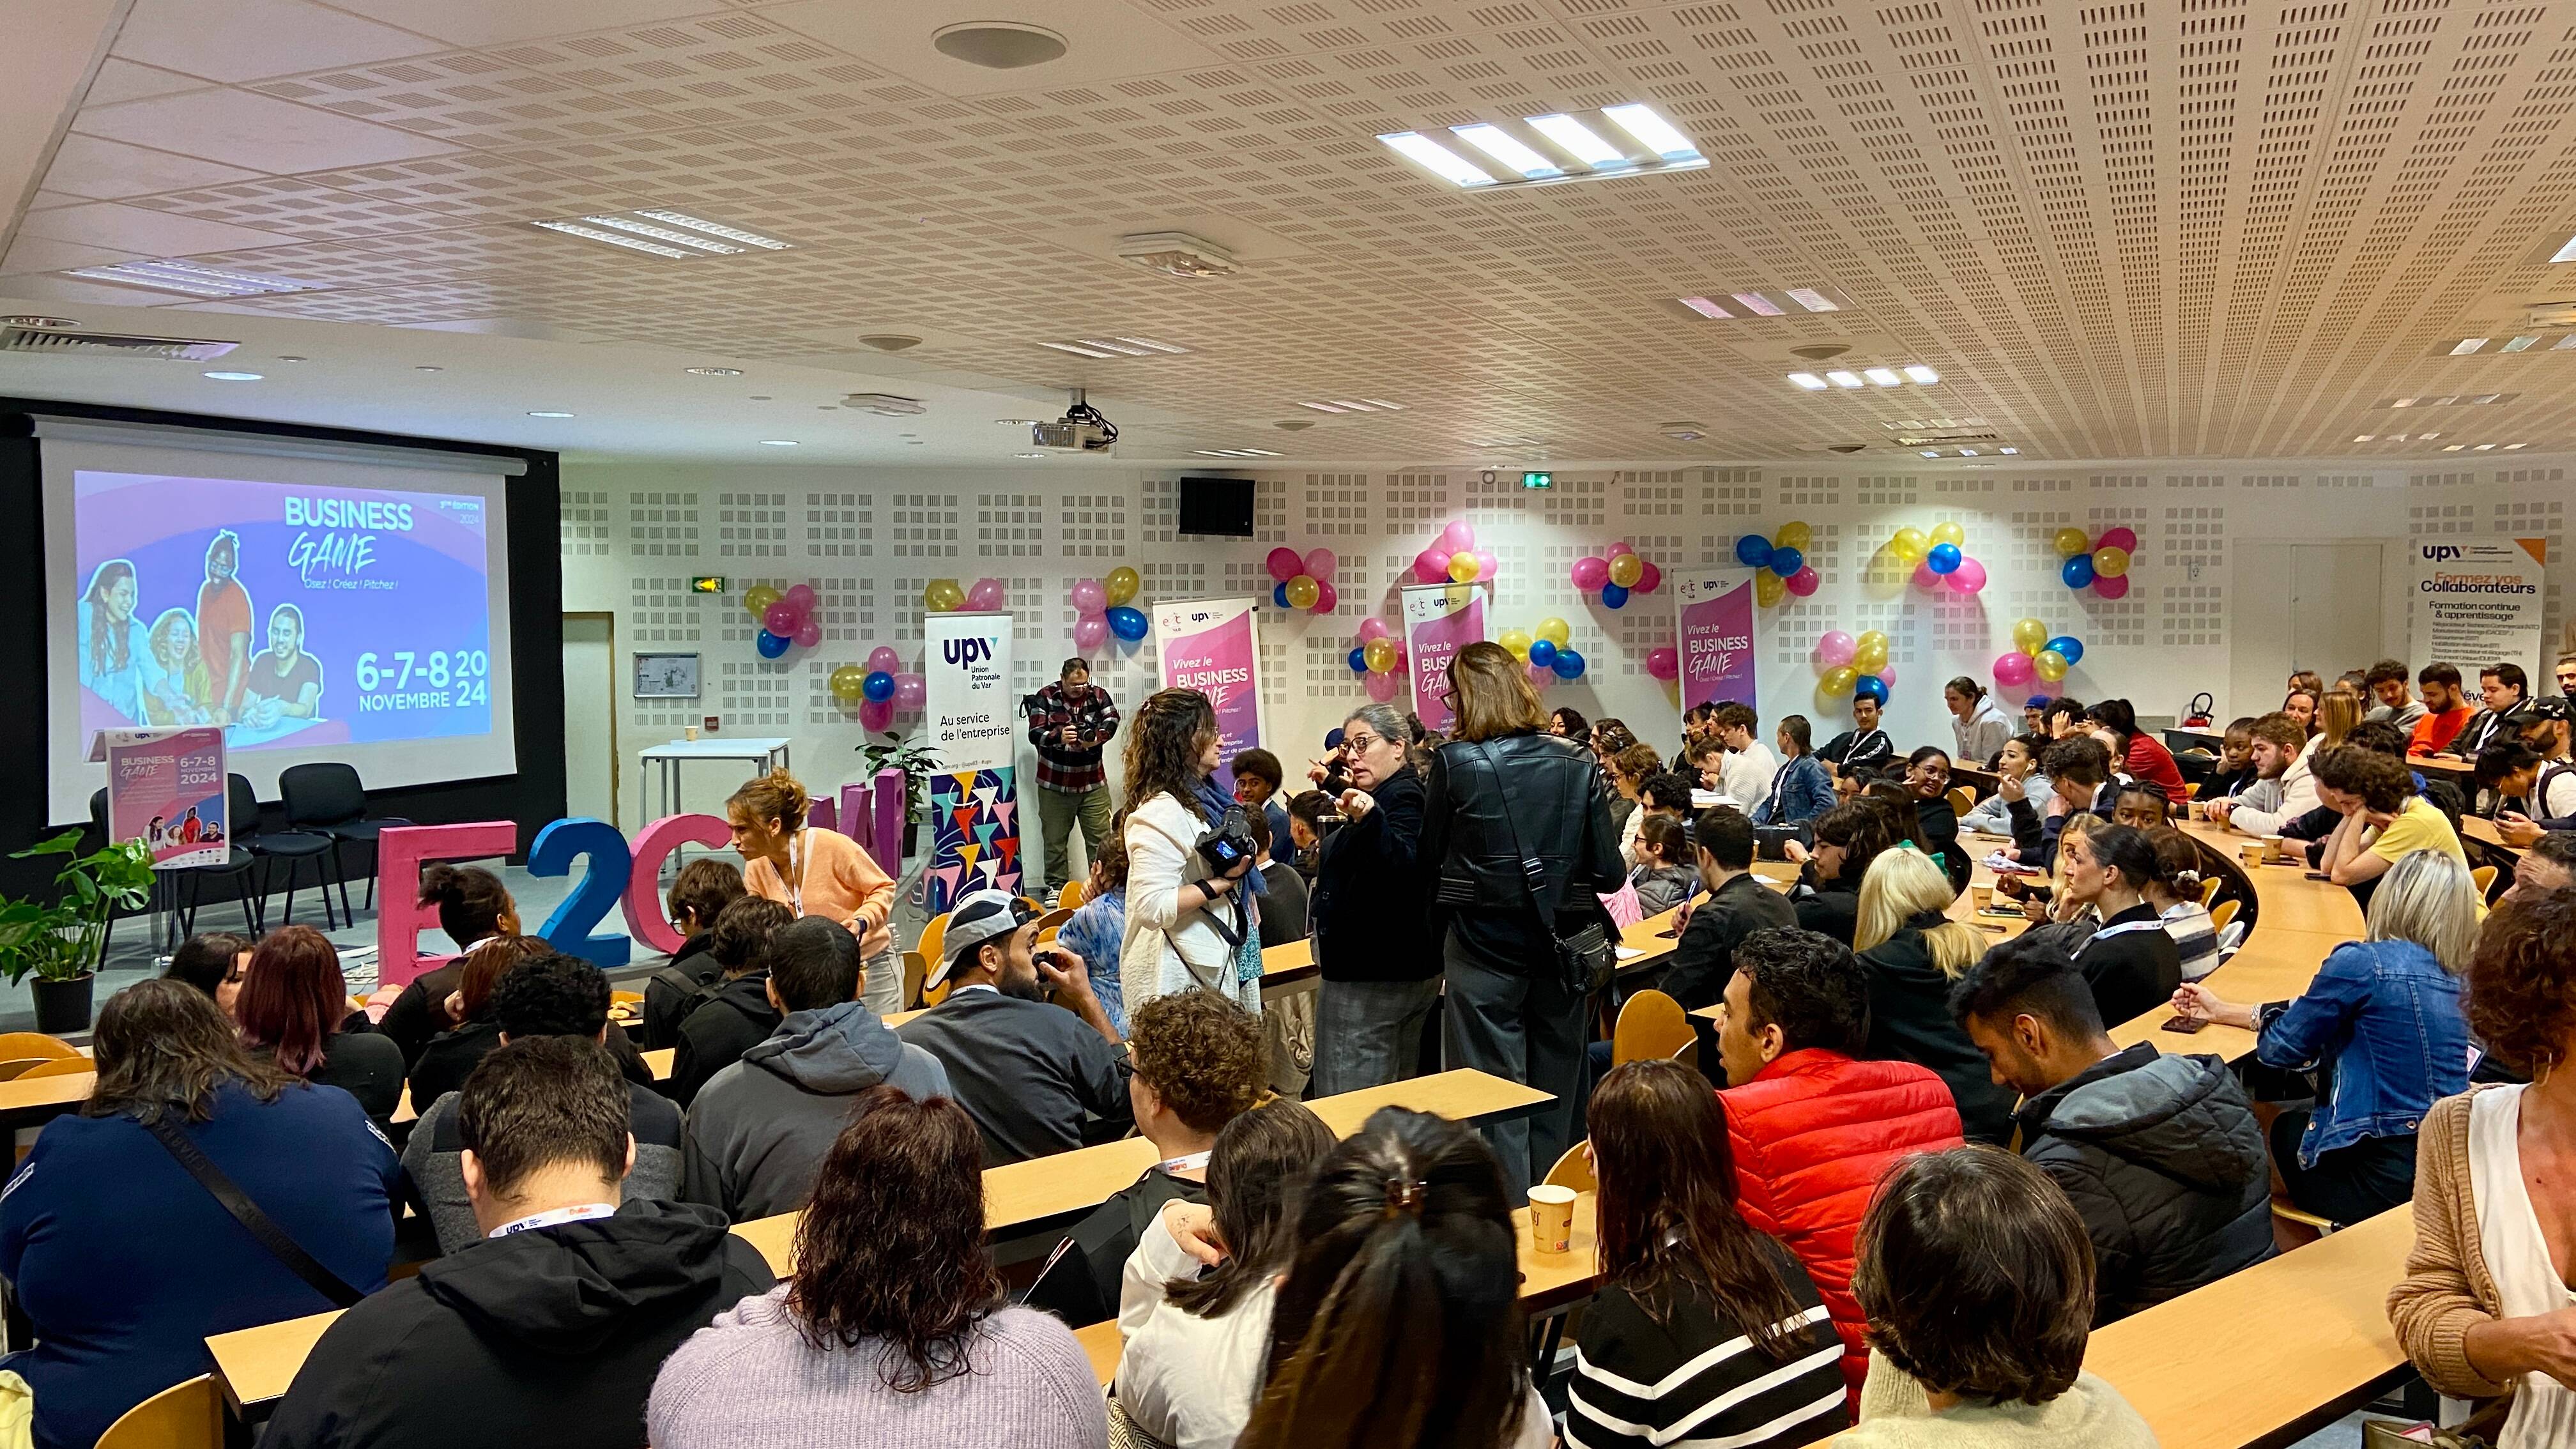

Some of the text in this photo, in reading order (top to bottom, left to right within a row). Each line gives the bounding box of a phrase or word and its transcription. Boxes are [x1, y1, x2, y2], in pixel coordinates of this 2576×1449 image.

[285, 496, 414, 532] BUSINESS
[288, 532, 377, 583] GAME
[2423, 546, 2467, 562] upv
[305, 578, 326, 589] Osez
[332, 578, 357, 590] Créez
[364, 579, 394, 590] Pitchez
[2435, 571, 2523, 585] Formez vos
[2421, 580, 2536, 594] Collaborateurs
[1434, 597, 1450, 608] upv
[2429, 601, 2520, 611] Formation continue
[1192, 612, 1211, 623] upv
[2435, 610, 2514, 622] & apprentissage
[1687, 623, 1719, 636] Vivez le
[1418, 641, 1452, 654] Vivez le
[1690, 636, 1748, 654] BUSINESS
[943, 637, 999, 670] upv
[356, 650, 450, 692] 6-7-8
[455, 650, 487, 677] 20
[1173, 656, 1213, 670] Vivez le
[1421, 656, 1453, 672] BUSI
[1689, 652, 1733, 682] GAME
[971, 673, 1000, 682] Patronale
[1176, 667, 1248, 689] BUSINESS
[456, 679, 487, 707] 24
[1421, 671, 1449, 701] GA
[359, 691, 450, 712] NOVEMBRE
[940, 712, 990, 727] Au service
[940, 724, 1010, 741] de l'entreprise
[121, 755, 216, 767] BUSINESS 6-7-8
[119, 765, 159, 781] GAME
[180, 773, 218, 785] 2024
